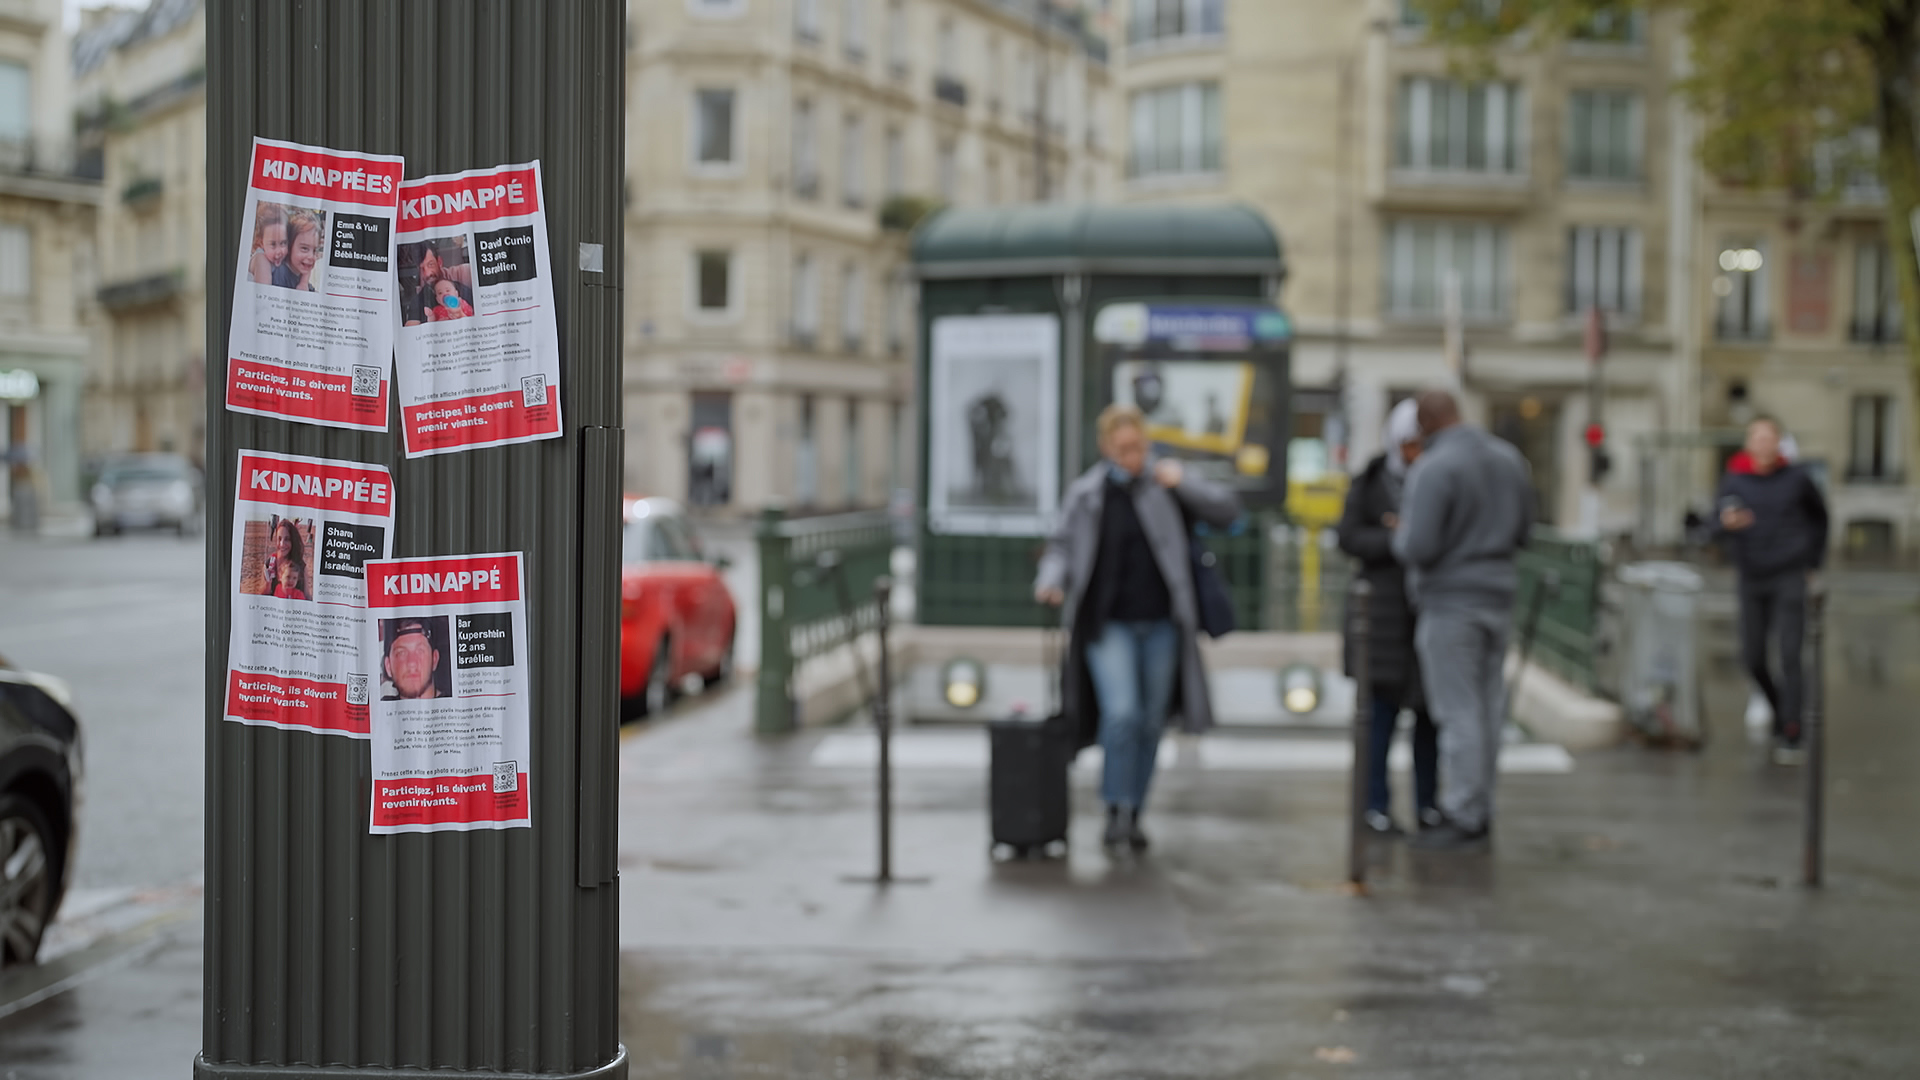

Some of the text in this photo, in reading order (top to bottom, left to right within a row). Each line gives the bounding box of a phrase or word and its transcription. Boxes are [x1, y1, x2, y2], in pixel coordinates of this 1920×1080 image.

[262, 159, 393, 194] KIDNAPPÉES
[402, 178, 525, 220] KIDNAPPÉ
[356, 222, 362, 230] &
[364, 223, 378, 232] Yuli
[335, 240, 340, 248] 3
[504, 234, 532, 246] Cunio
[480, 252, 494, 262] 33
[238, 368, 288, 386] Participz,
[292, 376, 306, 387] ils
[236, 381, 274, 394] revenir
[464, 404, 477, 414] ils
[480, 400, 514, 412] doient
[251, 468, 387, 504] KIDNAPPÉE
[325, 550, 336, 558] 34
[383, 564, 501, 596] KIDNAPPÉ
[458, 618, 472, 628] Bar
[458, 628, 506, 642] Kupershtin
[458, 643, 486, 652] 22 ans
[458, 653, 494, 664] Israélien
[239, 678, 286, 696] Participz,
[288, 686, 301, 694] ils
[382, 785, 434, 797] Participz,
[436, 784, 450, 794] ils
[382, 798, 420, 809] revenir
